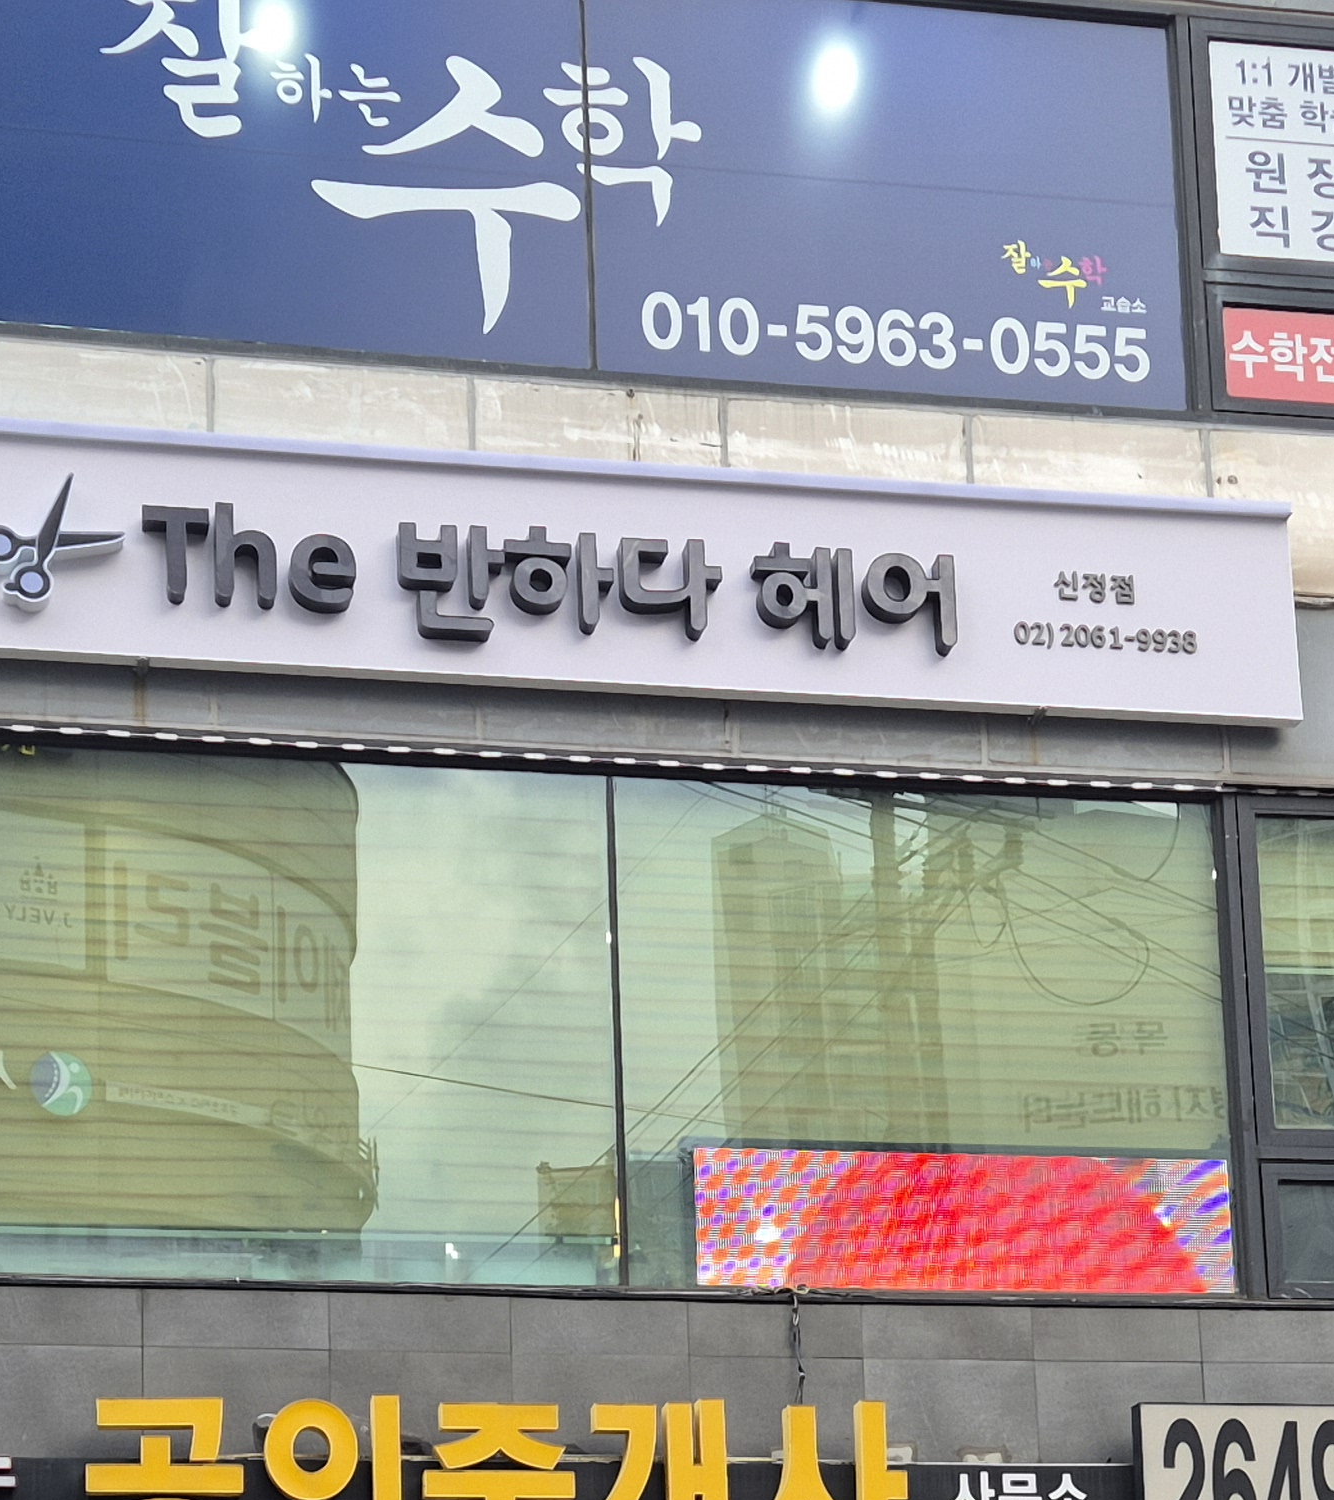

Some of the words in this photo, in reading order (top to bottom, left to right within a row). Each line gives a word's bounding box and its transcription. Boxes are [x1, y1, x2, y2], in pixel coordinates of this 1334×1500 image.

[1233, 58, 1274, 88] 1:1
[1226, 94, 1289, 131] 맞춤
[1100, 296, 1148, 314] 교습소
[641, 290, 1151, 383] 010-5963-0555
[141, 501, 358, 613] The
[396, 521, 723, 643] 반하다
[749, 541, 959, 657] 헤어
[1052, 569, 1137, 606] 신정점
